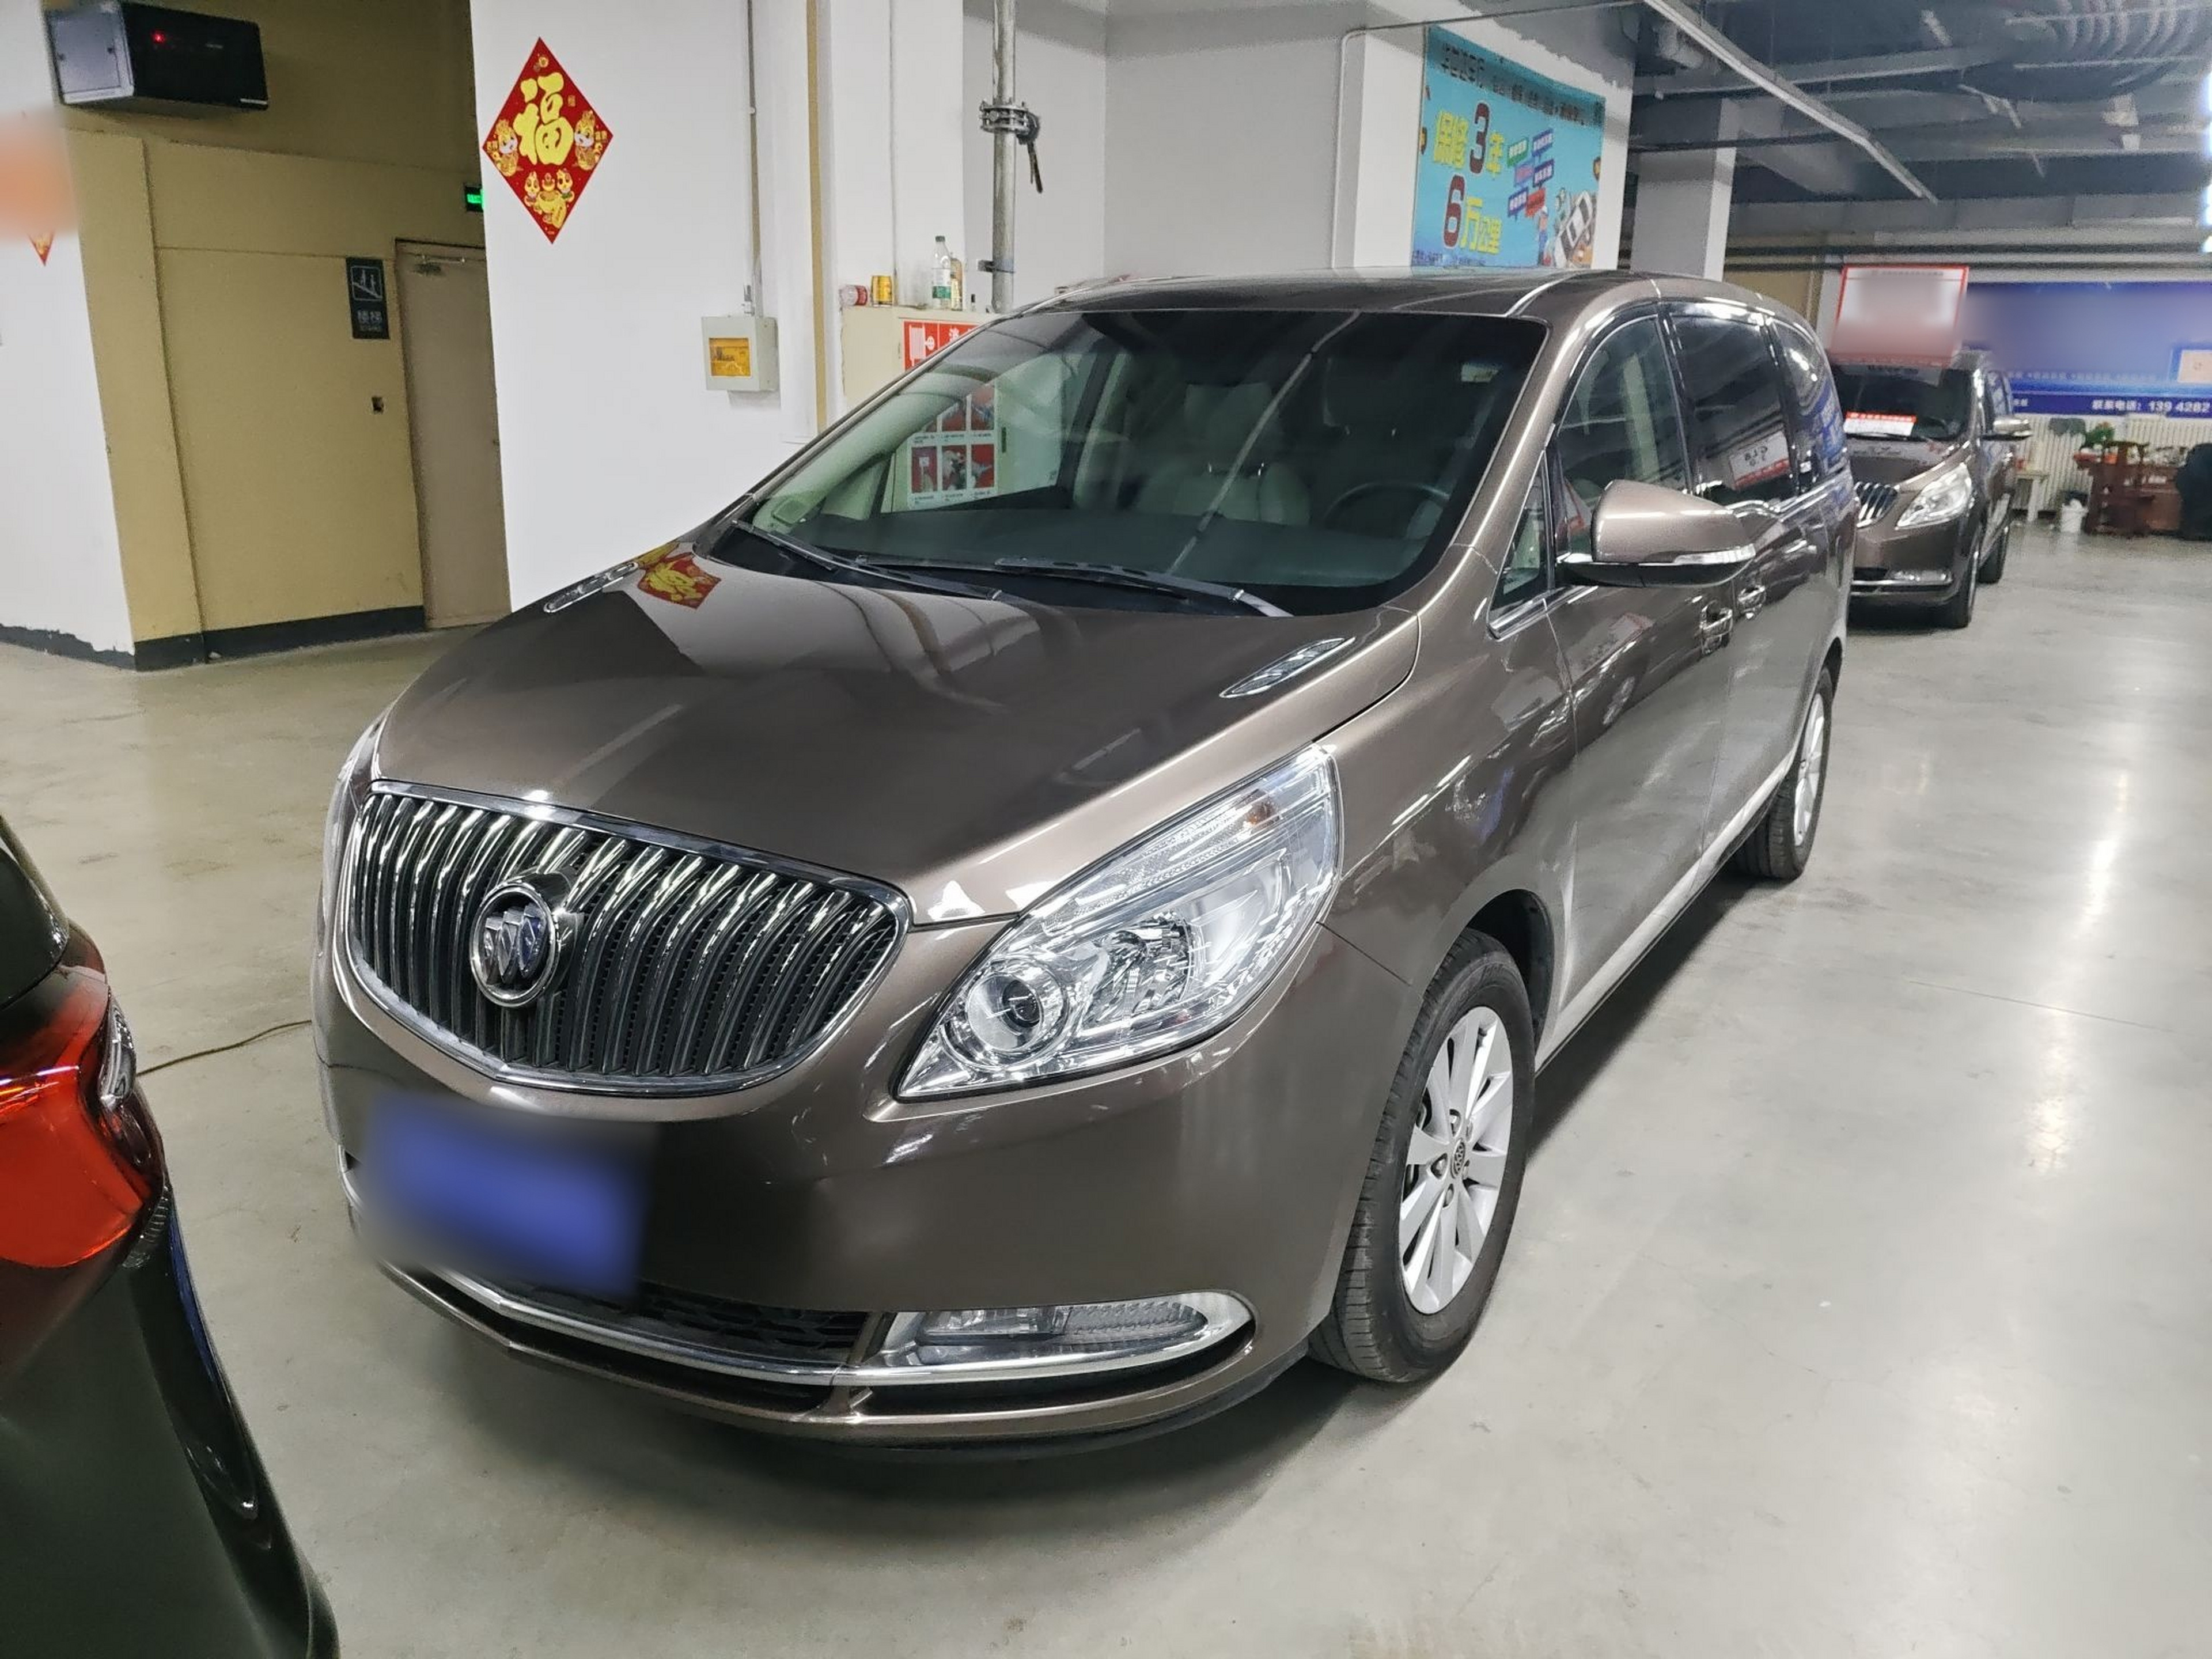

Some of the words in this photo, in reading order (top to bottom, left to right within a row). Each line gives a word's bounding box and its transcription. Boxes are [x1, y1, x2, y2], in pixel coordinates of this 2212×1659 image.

[513, 72, 574, 166] 福
[1442, 173, 1502, 256] 6万公里
